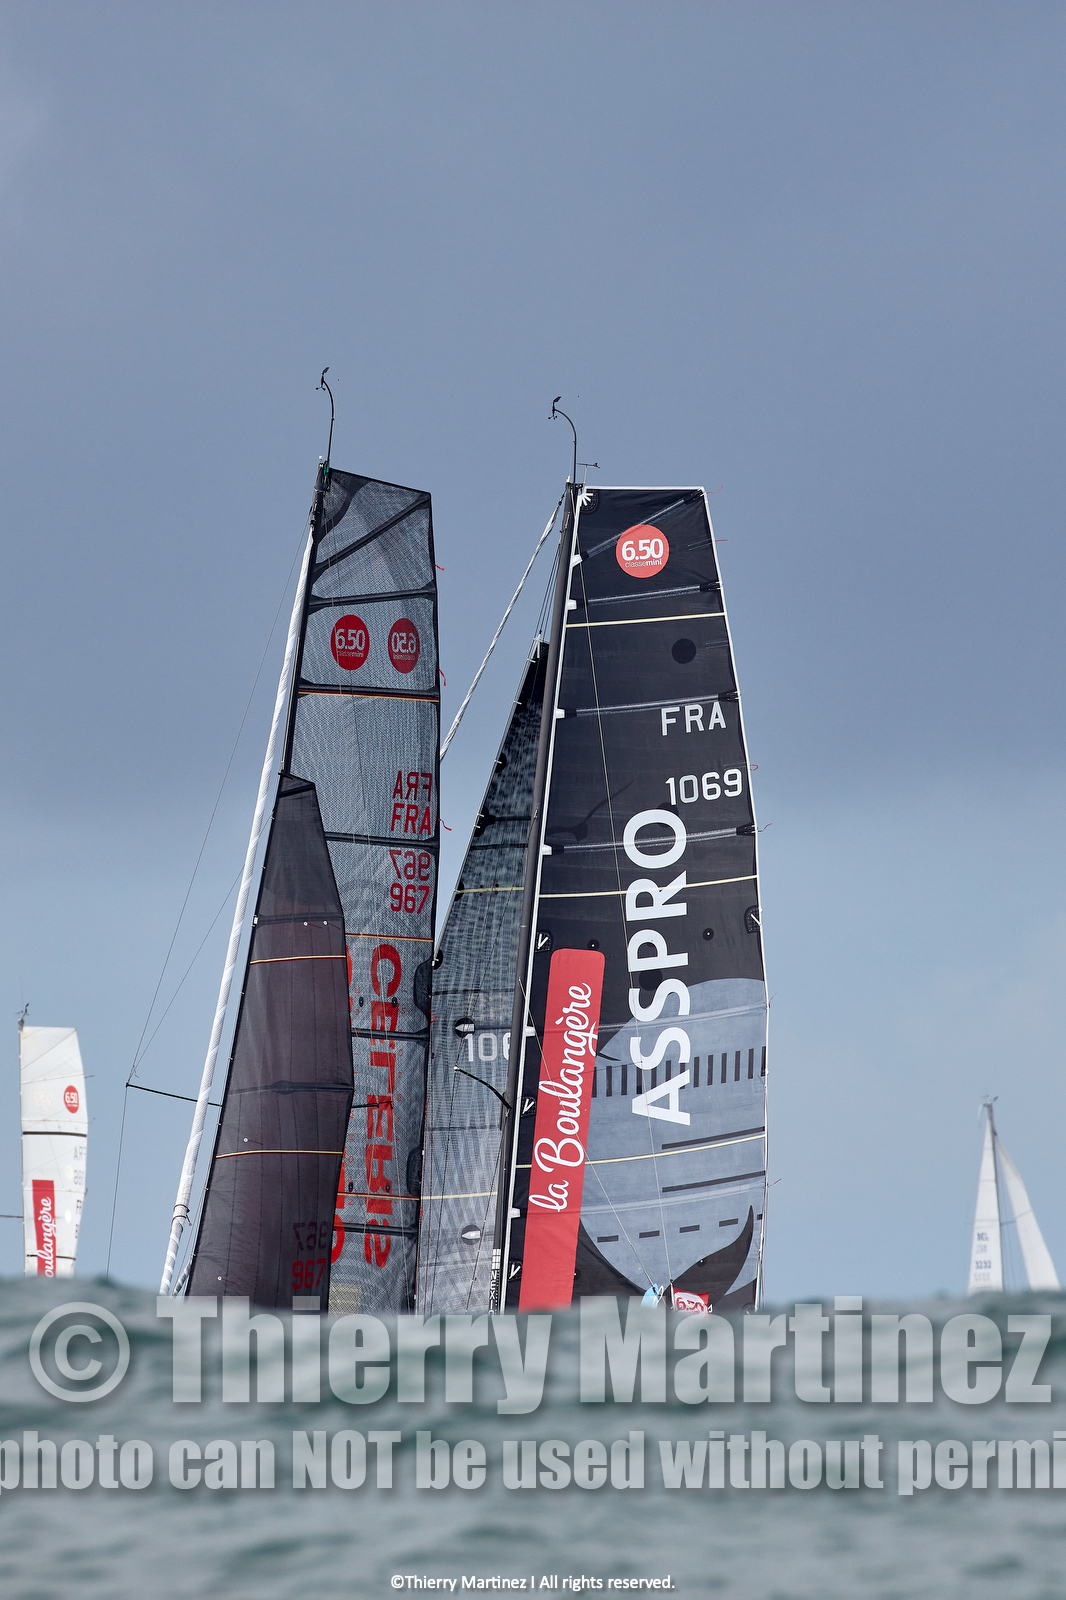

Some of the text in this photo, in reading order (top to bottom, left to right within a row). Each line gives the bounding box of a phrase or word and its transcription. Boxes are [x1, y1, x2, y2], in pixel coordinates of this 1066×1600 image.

[621, 538, 664, 561] 6.50
[625, 558, 662, 568] classemini
[335, 628, 365, 651] 6.50
[661, 702, 726, 736] FRA
[665, 769, 742, 805] 1069
[391, 803, 431, 835] FRA
[390, 883, 430, 914] 967
[623, 809, 691, 1125] ASSPRO
[529, 982, 599, 1212] la Boulangère
[292, 1258, 326, 1290] 967
